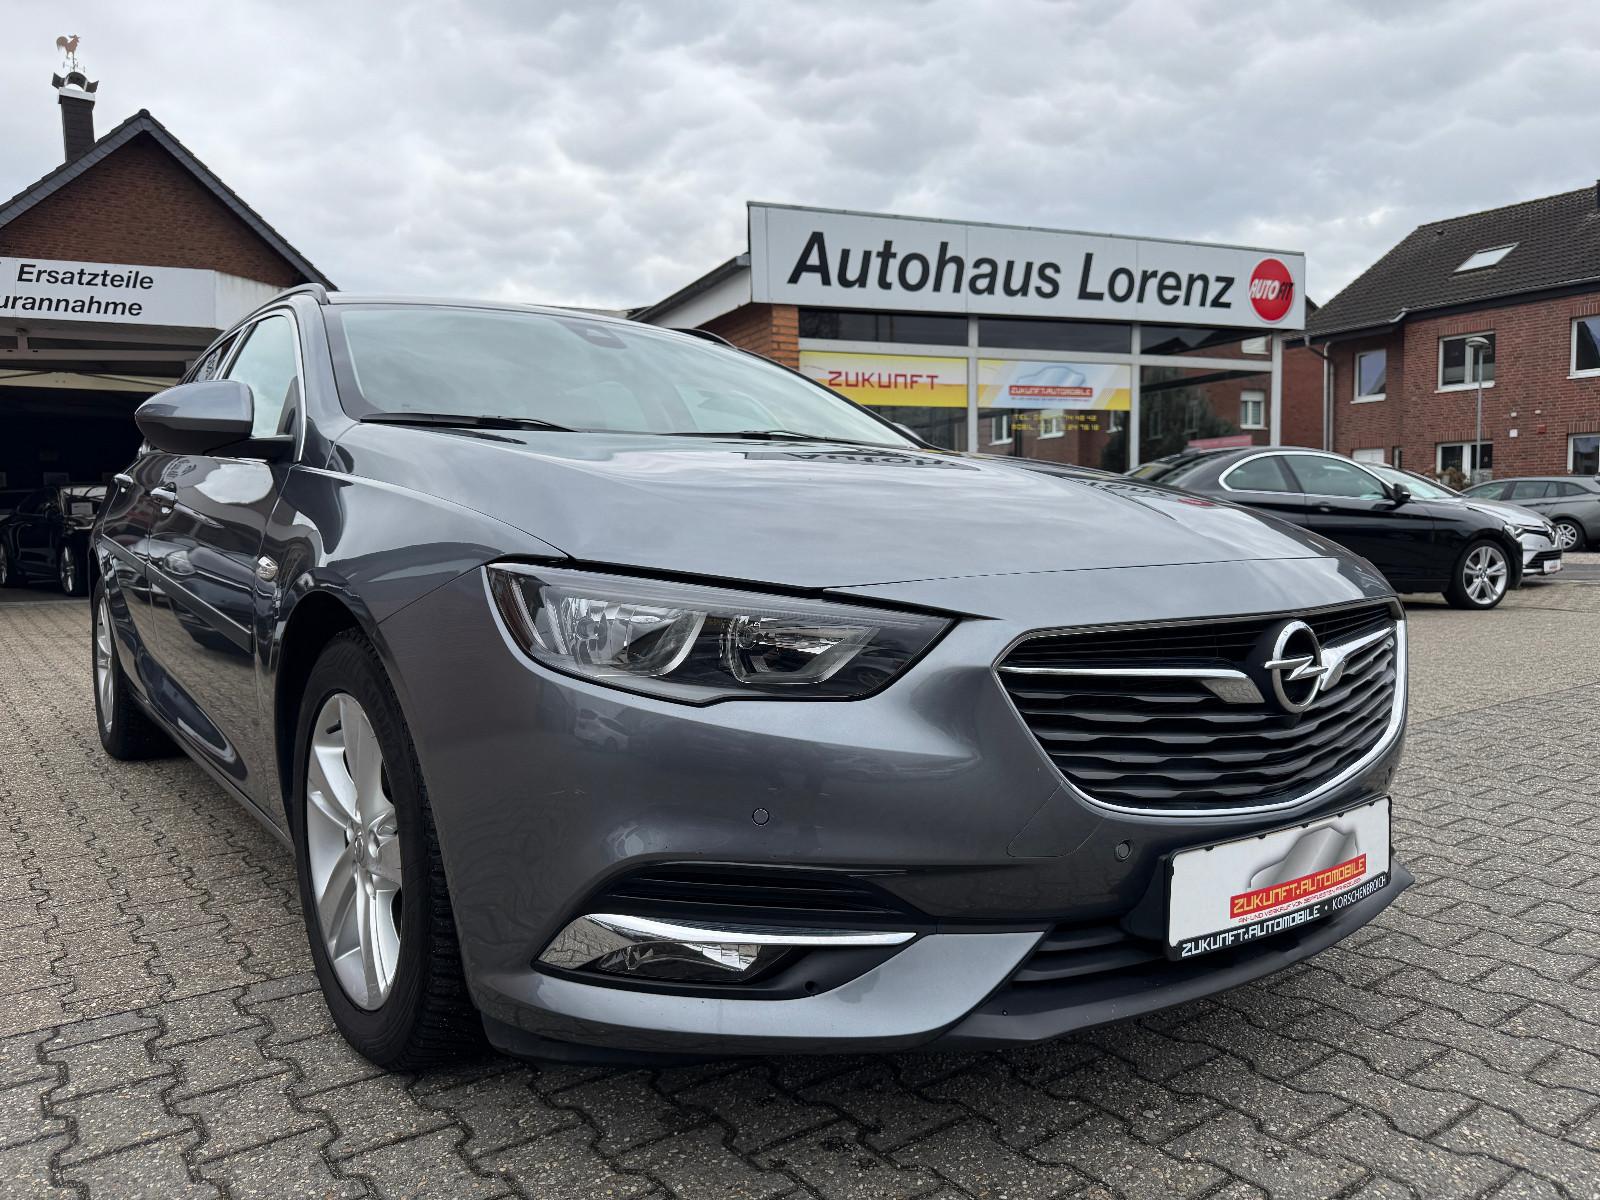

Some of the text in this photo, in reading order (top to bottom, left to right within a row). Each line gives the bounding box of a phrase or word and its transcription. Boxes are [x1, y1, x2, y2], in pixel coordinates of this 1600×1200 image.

[17, 263, 154, 290] Ersatzteile
[788, 231, 1235, 309] Autohaus Lorenz
[828, 370, 939, 390] ZUKUNFT
[1233, 883, 1298, 914] ZUKUNFT
[1300, 858, 1365, 893] AUTOMOBILE
[1181, 927, 1246, 958] ZUKUNFT
[1248, 904, 1321, 940] AUTOMOBILE
